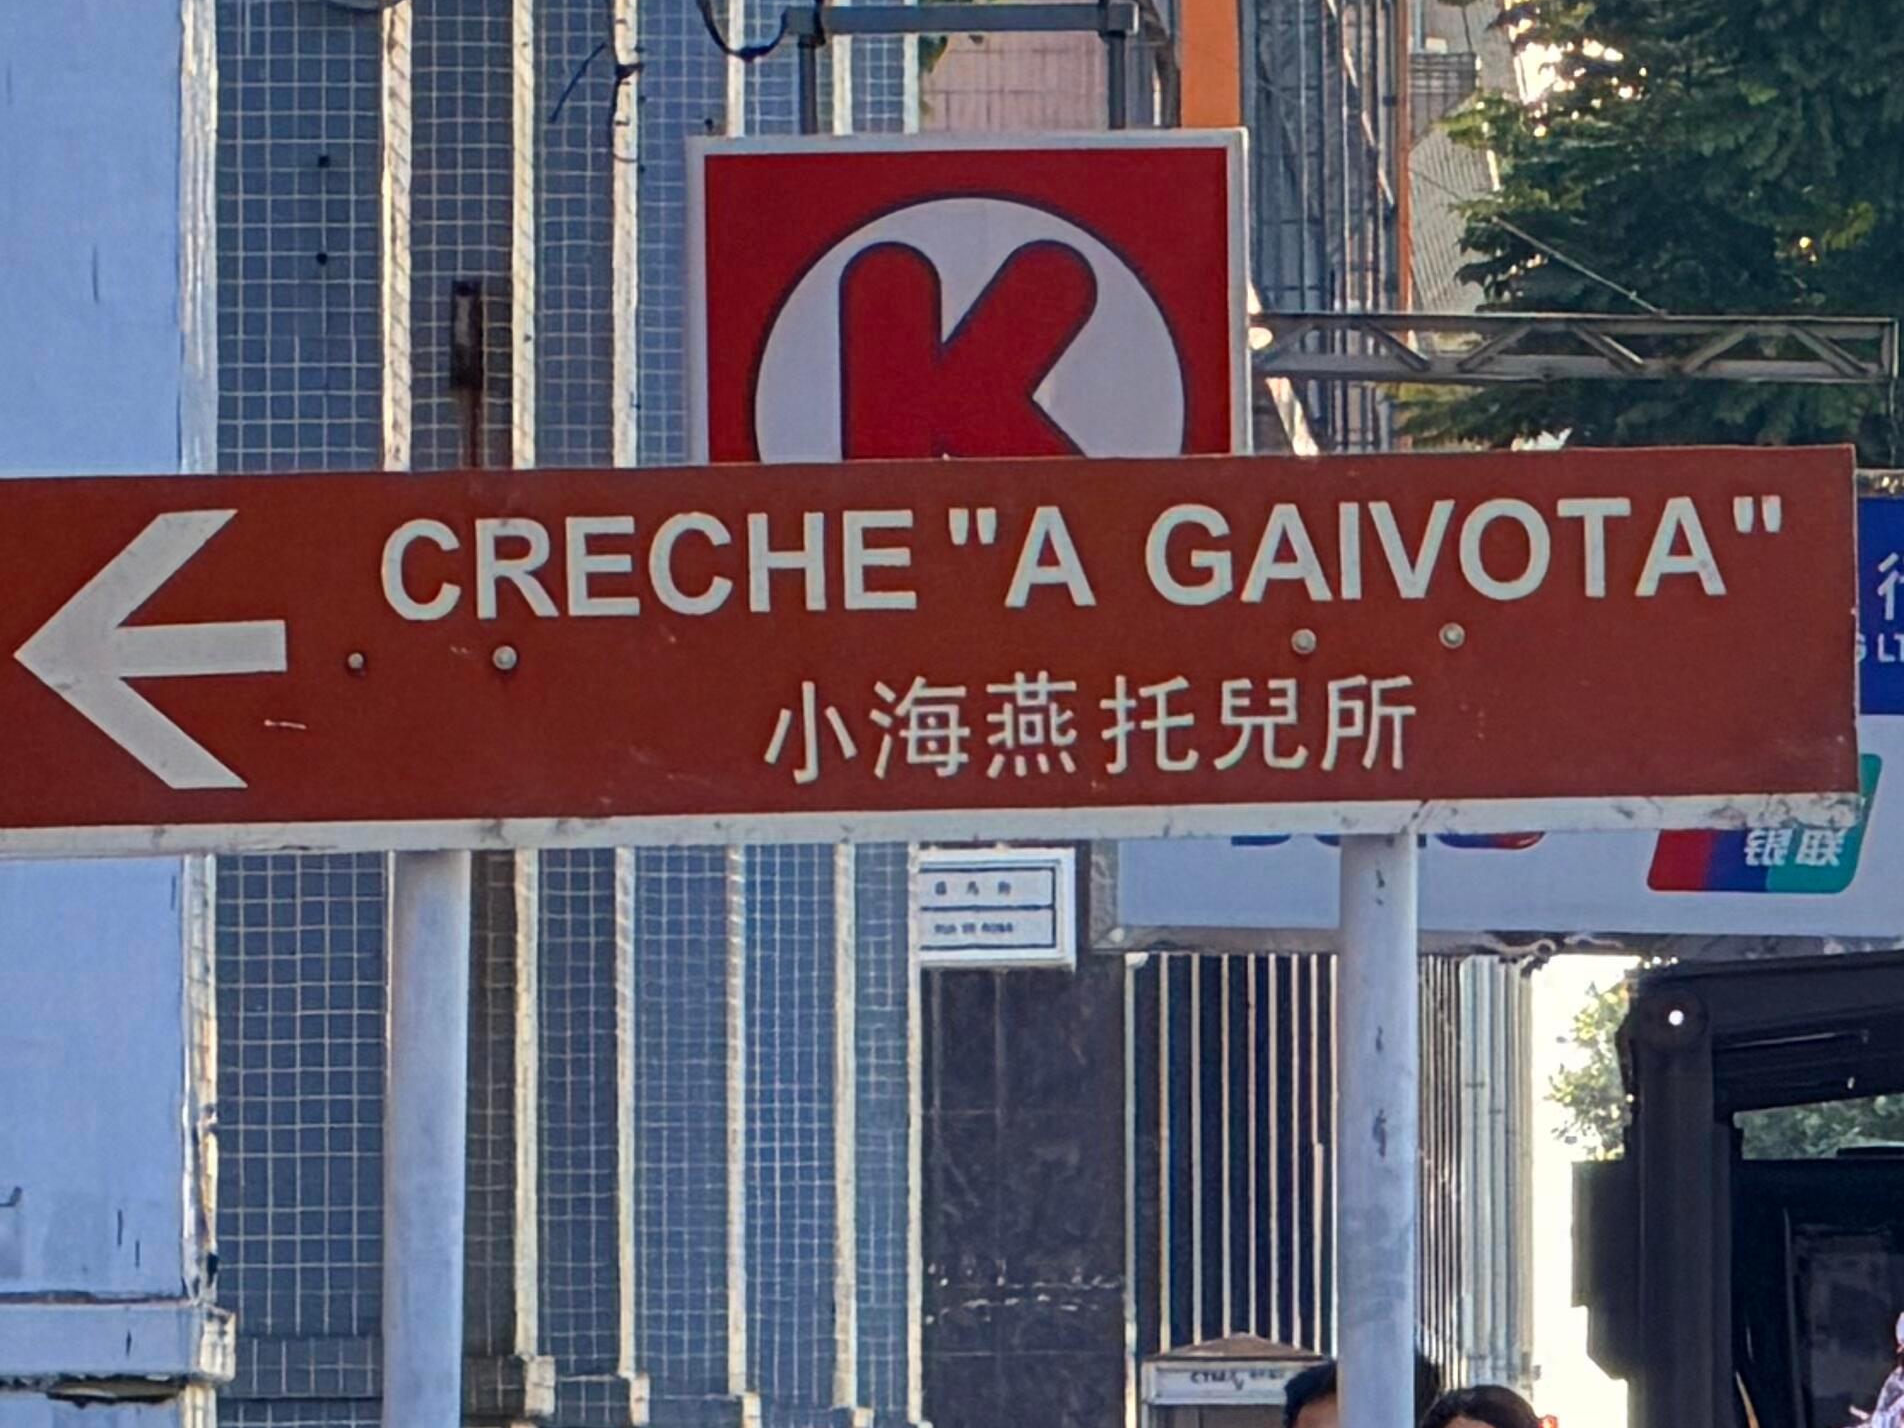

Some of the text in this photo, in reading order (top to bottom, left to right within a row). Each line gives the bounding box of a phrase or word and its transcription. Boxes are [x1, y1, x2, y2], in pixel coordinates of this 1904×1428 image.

[838, 239, 1100, 460] K
[381, 495, 1782, 620] CRECHE "A GAIVOTA"
[765, 670, 1417, 784] 小海燕托兒所
